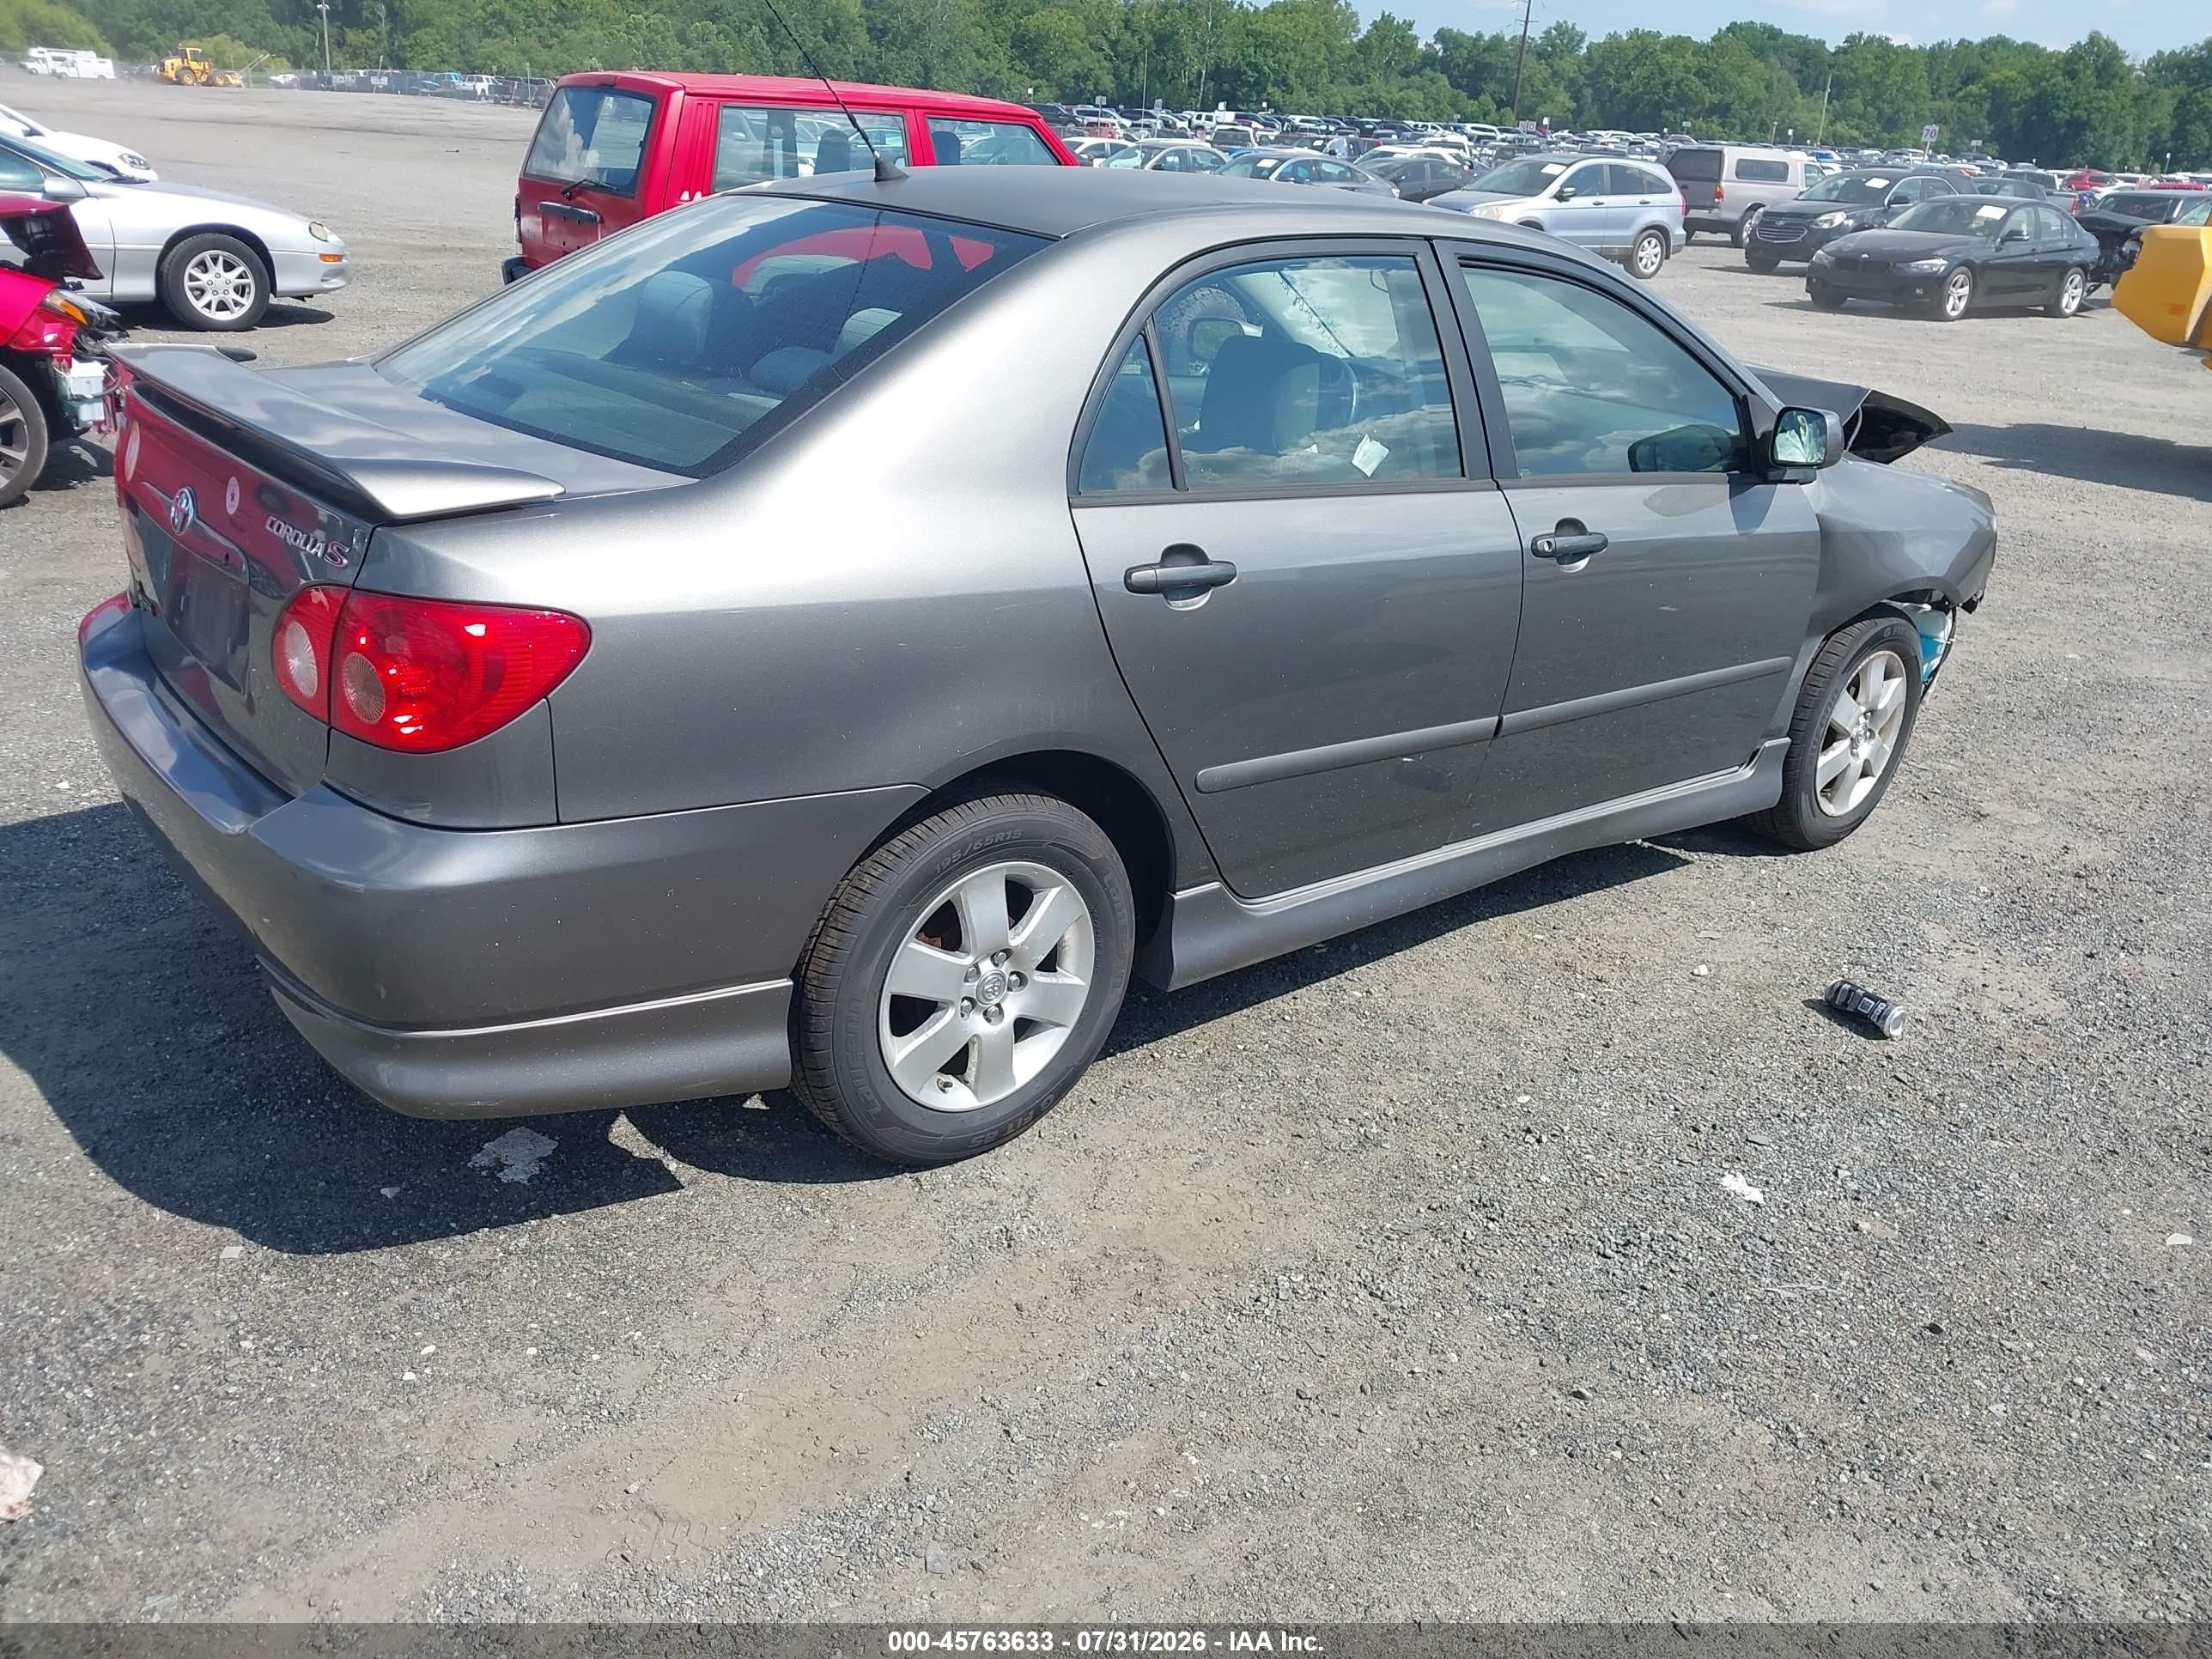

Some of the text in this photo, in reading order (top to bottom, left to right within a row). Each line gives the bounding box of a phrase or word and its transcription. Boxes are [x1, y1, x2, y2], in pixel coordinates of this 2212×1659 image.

[1923, 128, 1937, 139] 70
[264, 516, 350, 568] COROLLA S
[935, 829, 1023, 874] 195/65R15
[1003, 1109, 1034, 1136] FIT
